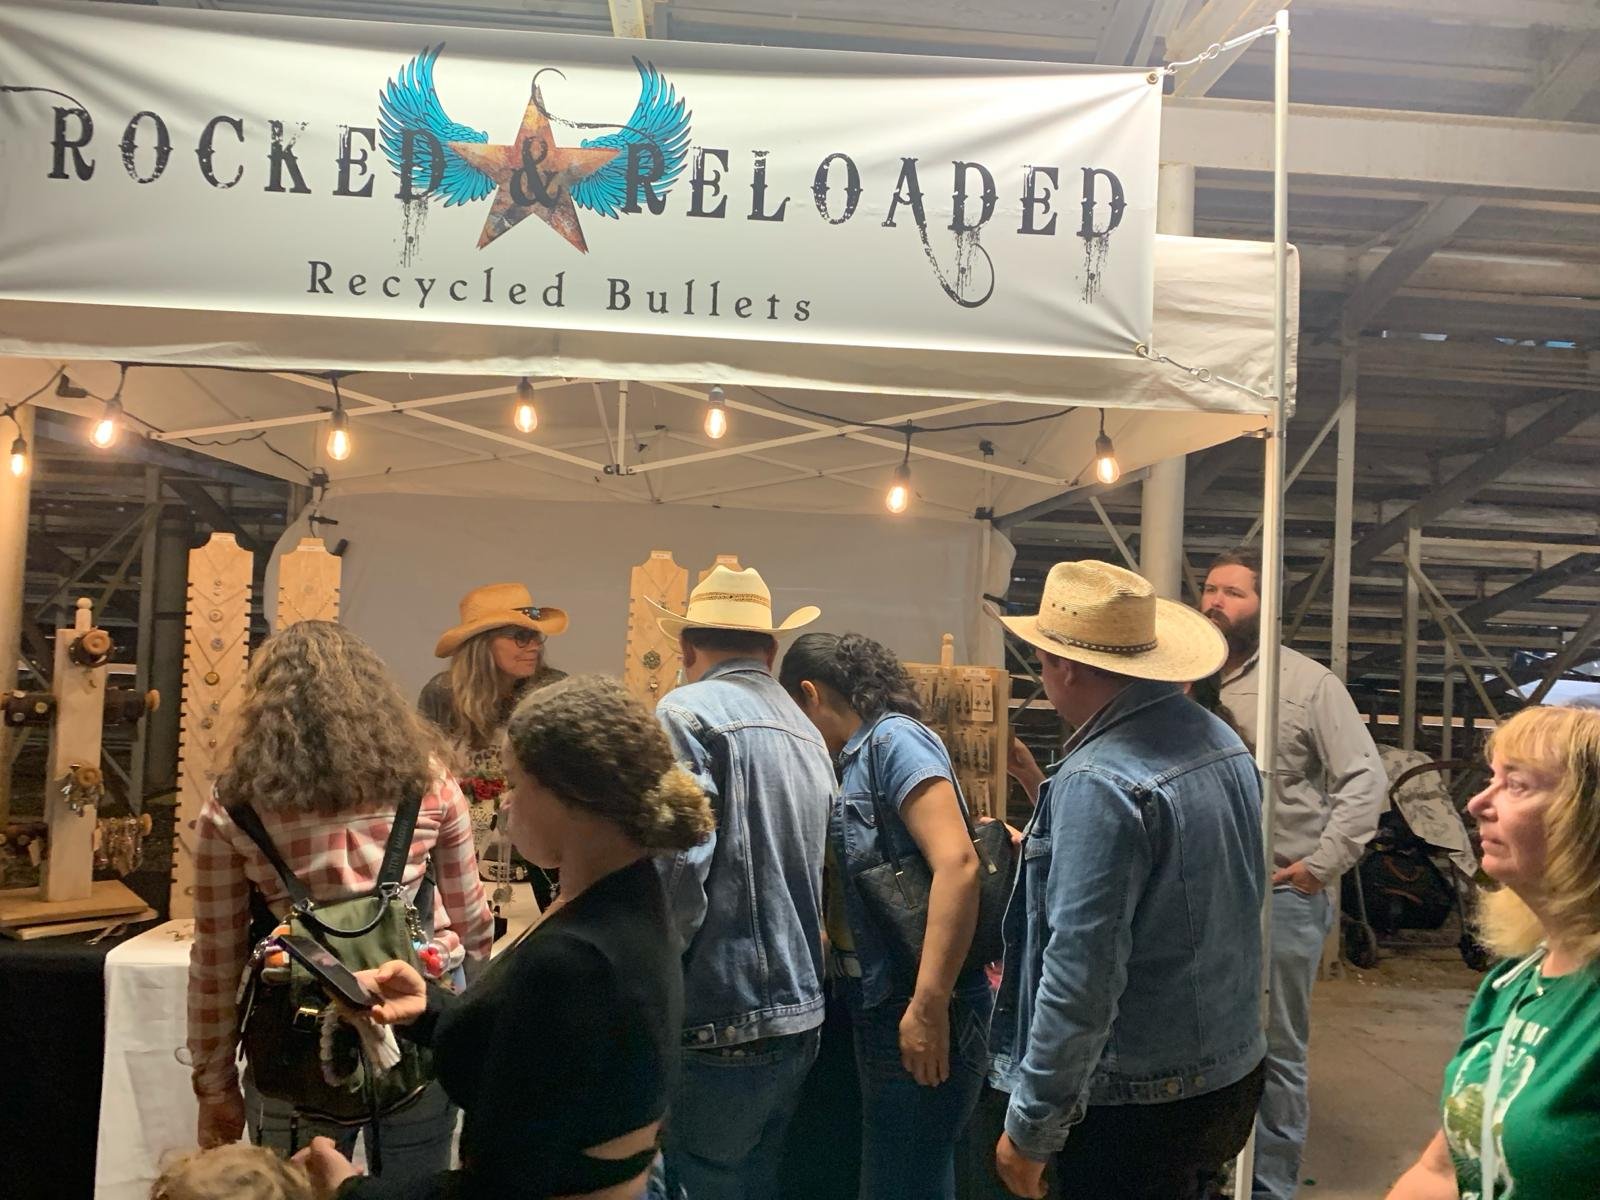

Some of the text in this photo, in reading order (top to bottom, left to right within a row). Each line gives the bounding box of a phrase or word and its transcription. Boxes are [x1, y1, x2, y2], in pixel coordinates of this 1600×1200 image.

[46, 104, 1129, 244] ROCKED & RELOADED
[306, 260, 812, 322] Recycled Bullets
